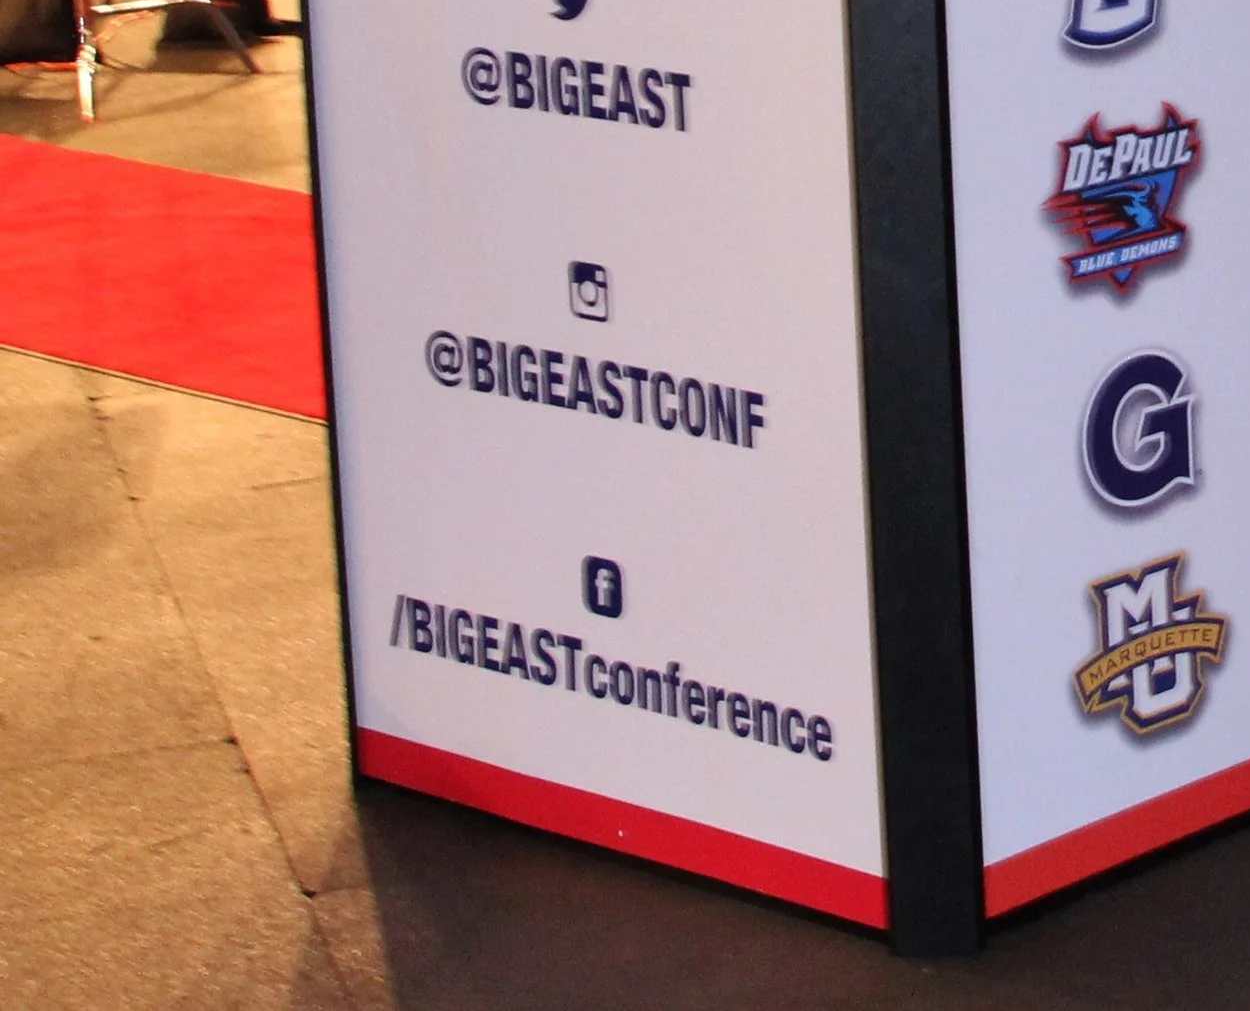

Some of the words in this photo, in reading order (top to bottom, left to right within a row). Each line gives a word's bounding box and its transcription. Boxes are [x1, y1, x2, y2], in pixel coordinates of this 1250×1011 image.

[461, 47, 691, 131] @BIGEAST
[1078, 252, 1115, 273] BLUE
[1120, 236, 1177, 261] DEMONS
[425, 330, 765, 448] @BIGEASTCONF
[1083, 348, 1195, 506] G
[389, 594, 832, 761] /BIGEASTconference
[1088, 627, 1213, 685] MARQUETTE
